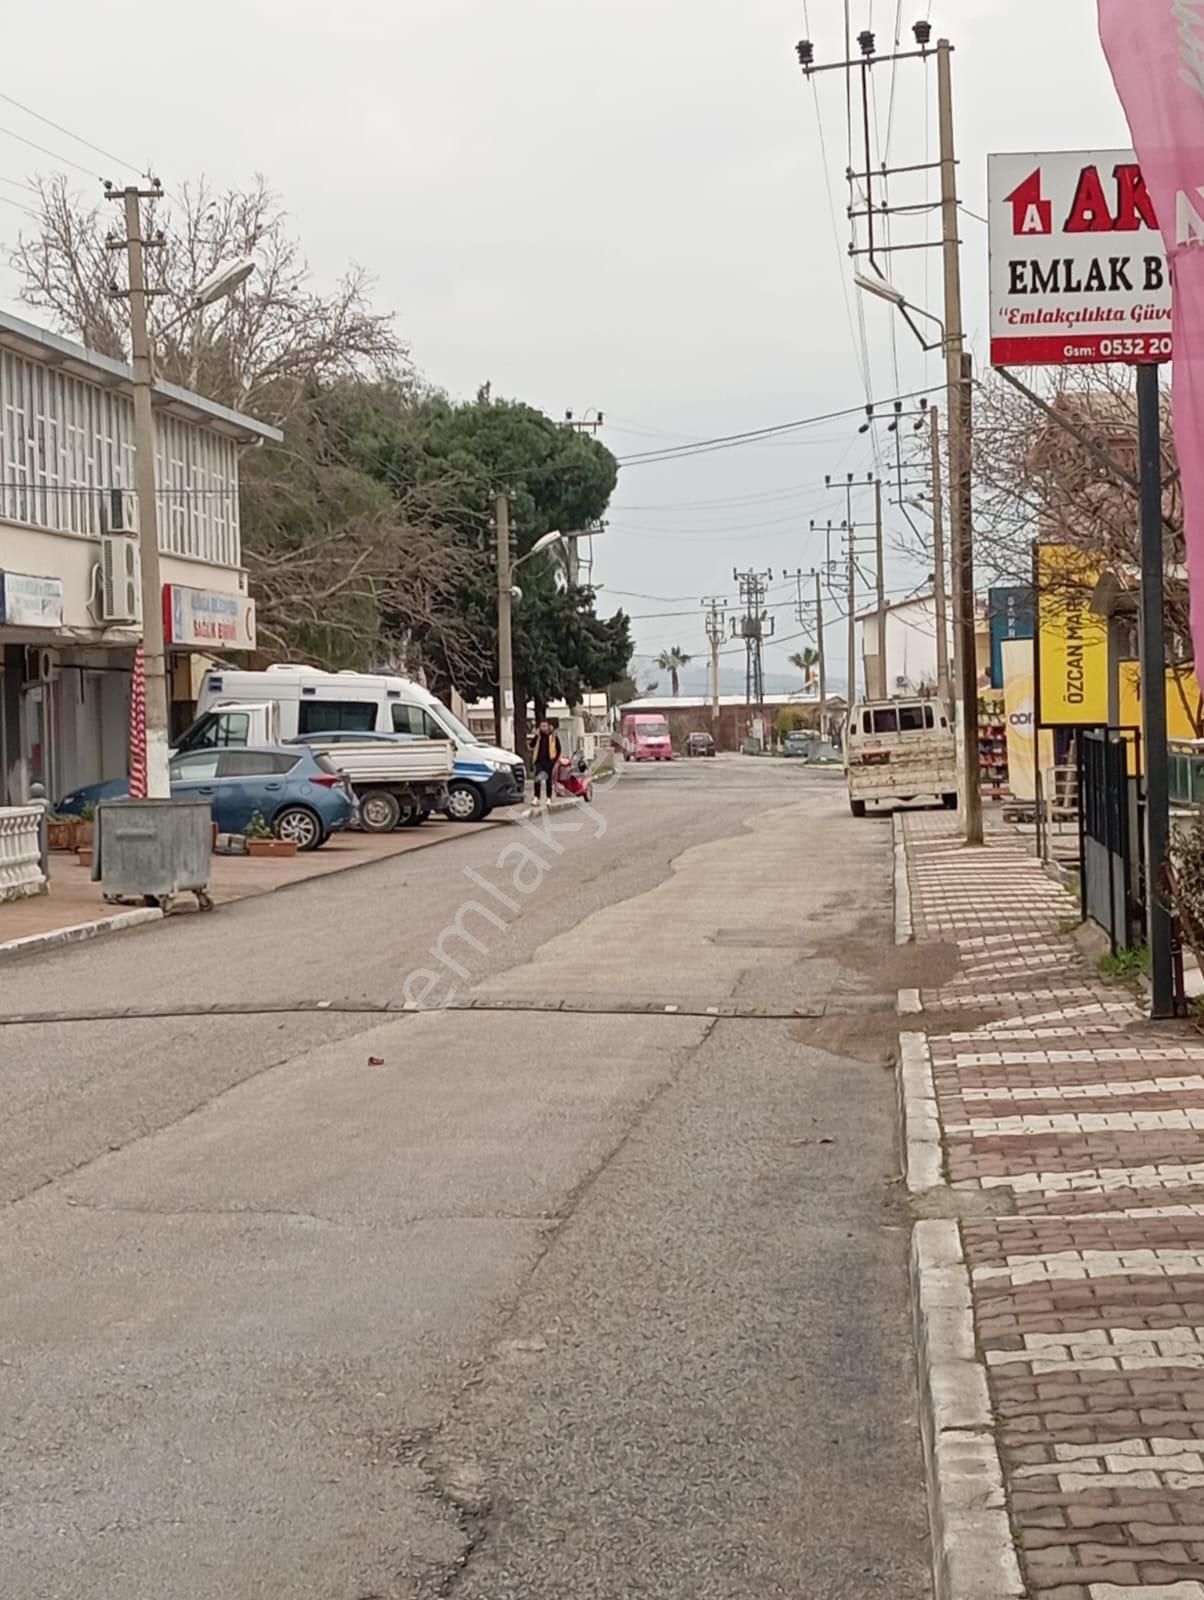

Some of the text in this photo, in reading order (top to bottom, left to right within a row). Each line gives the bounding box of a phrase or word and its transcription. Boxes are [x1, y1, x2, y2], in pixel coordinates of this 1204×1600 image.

[1008, 256, 1173, 295] EMLAK B
[1063, 344, 1095, 357] Gsm:
[1100, 339, 1145, 355] 0532
[1063, 645, 1084, 704] ÖZCAN
